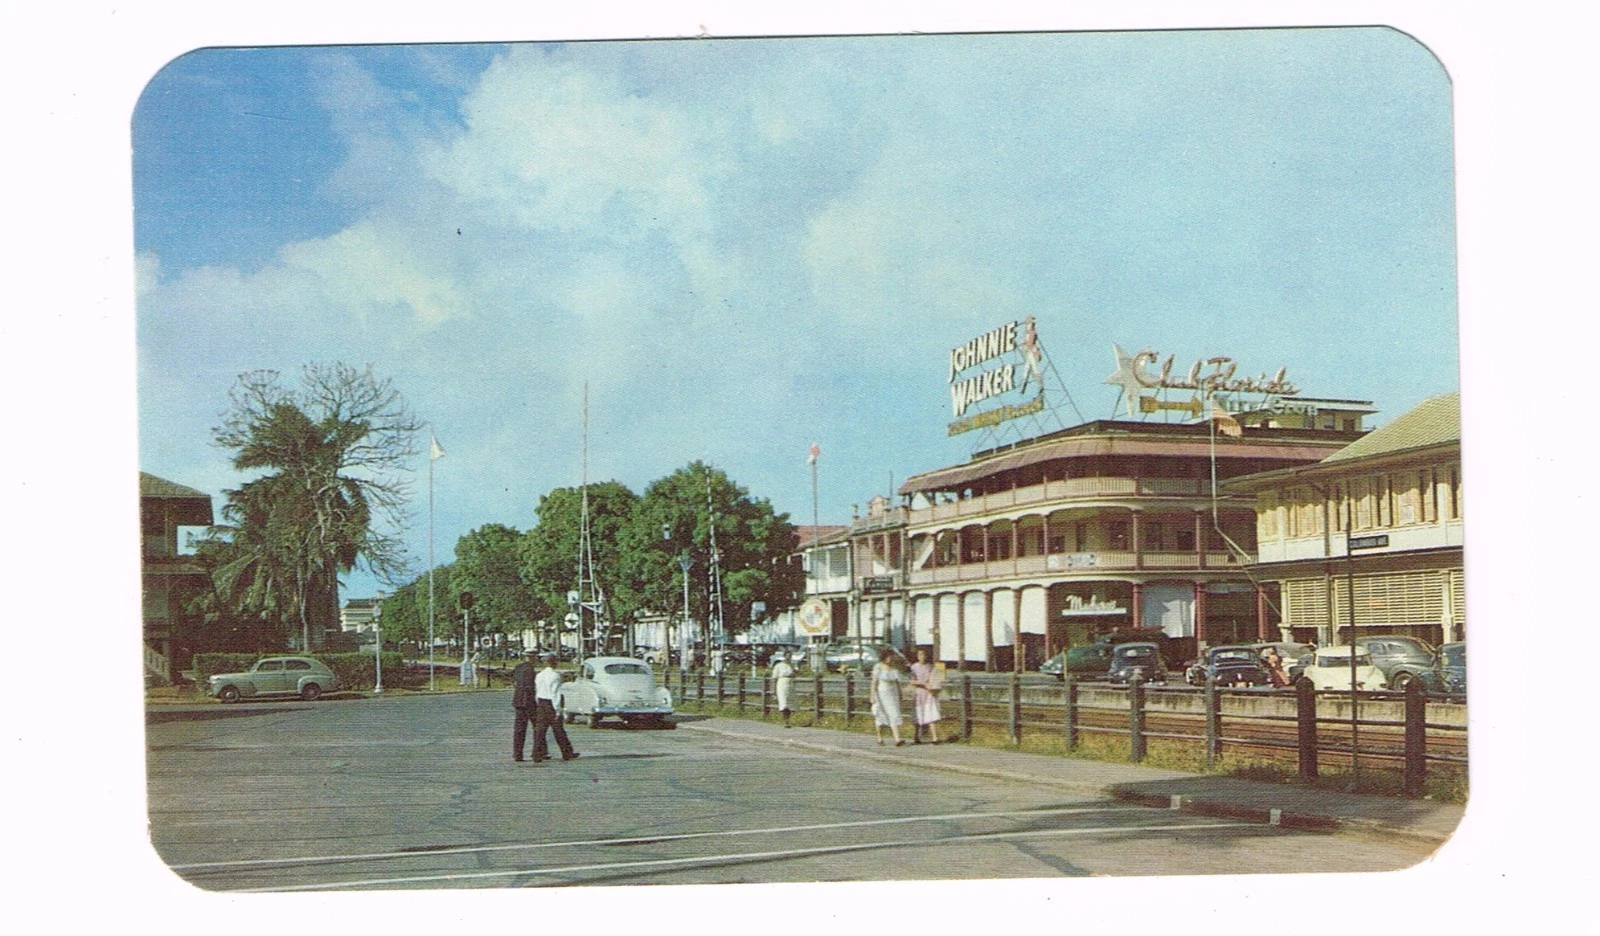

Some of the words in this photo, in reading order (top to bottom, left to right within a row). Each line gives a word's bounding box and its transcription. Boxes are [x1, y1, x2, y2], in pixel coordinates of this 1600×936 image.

[949, 320, 1018, 383] JOHNNIE
[1132, 347, 1200, 388] Club
[1204, 356, 1301, 400] Florida
[951, 363, 1016, 417] WALKER
